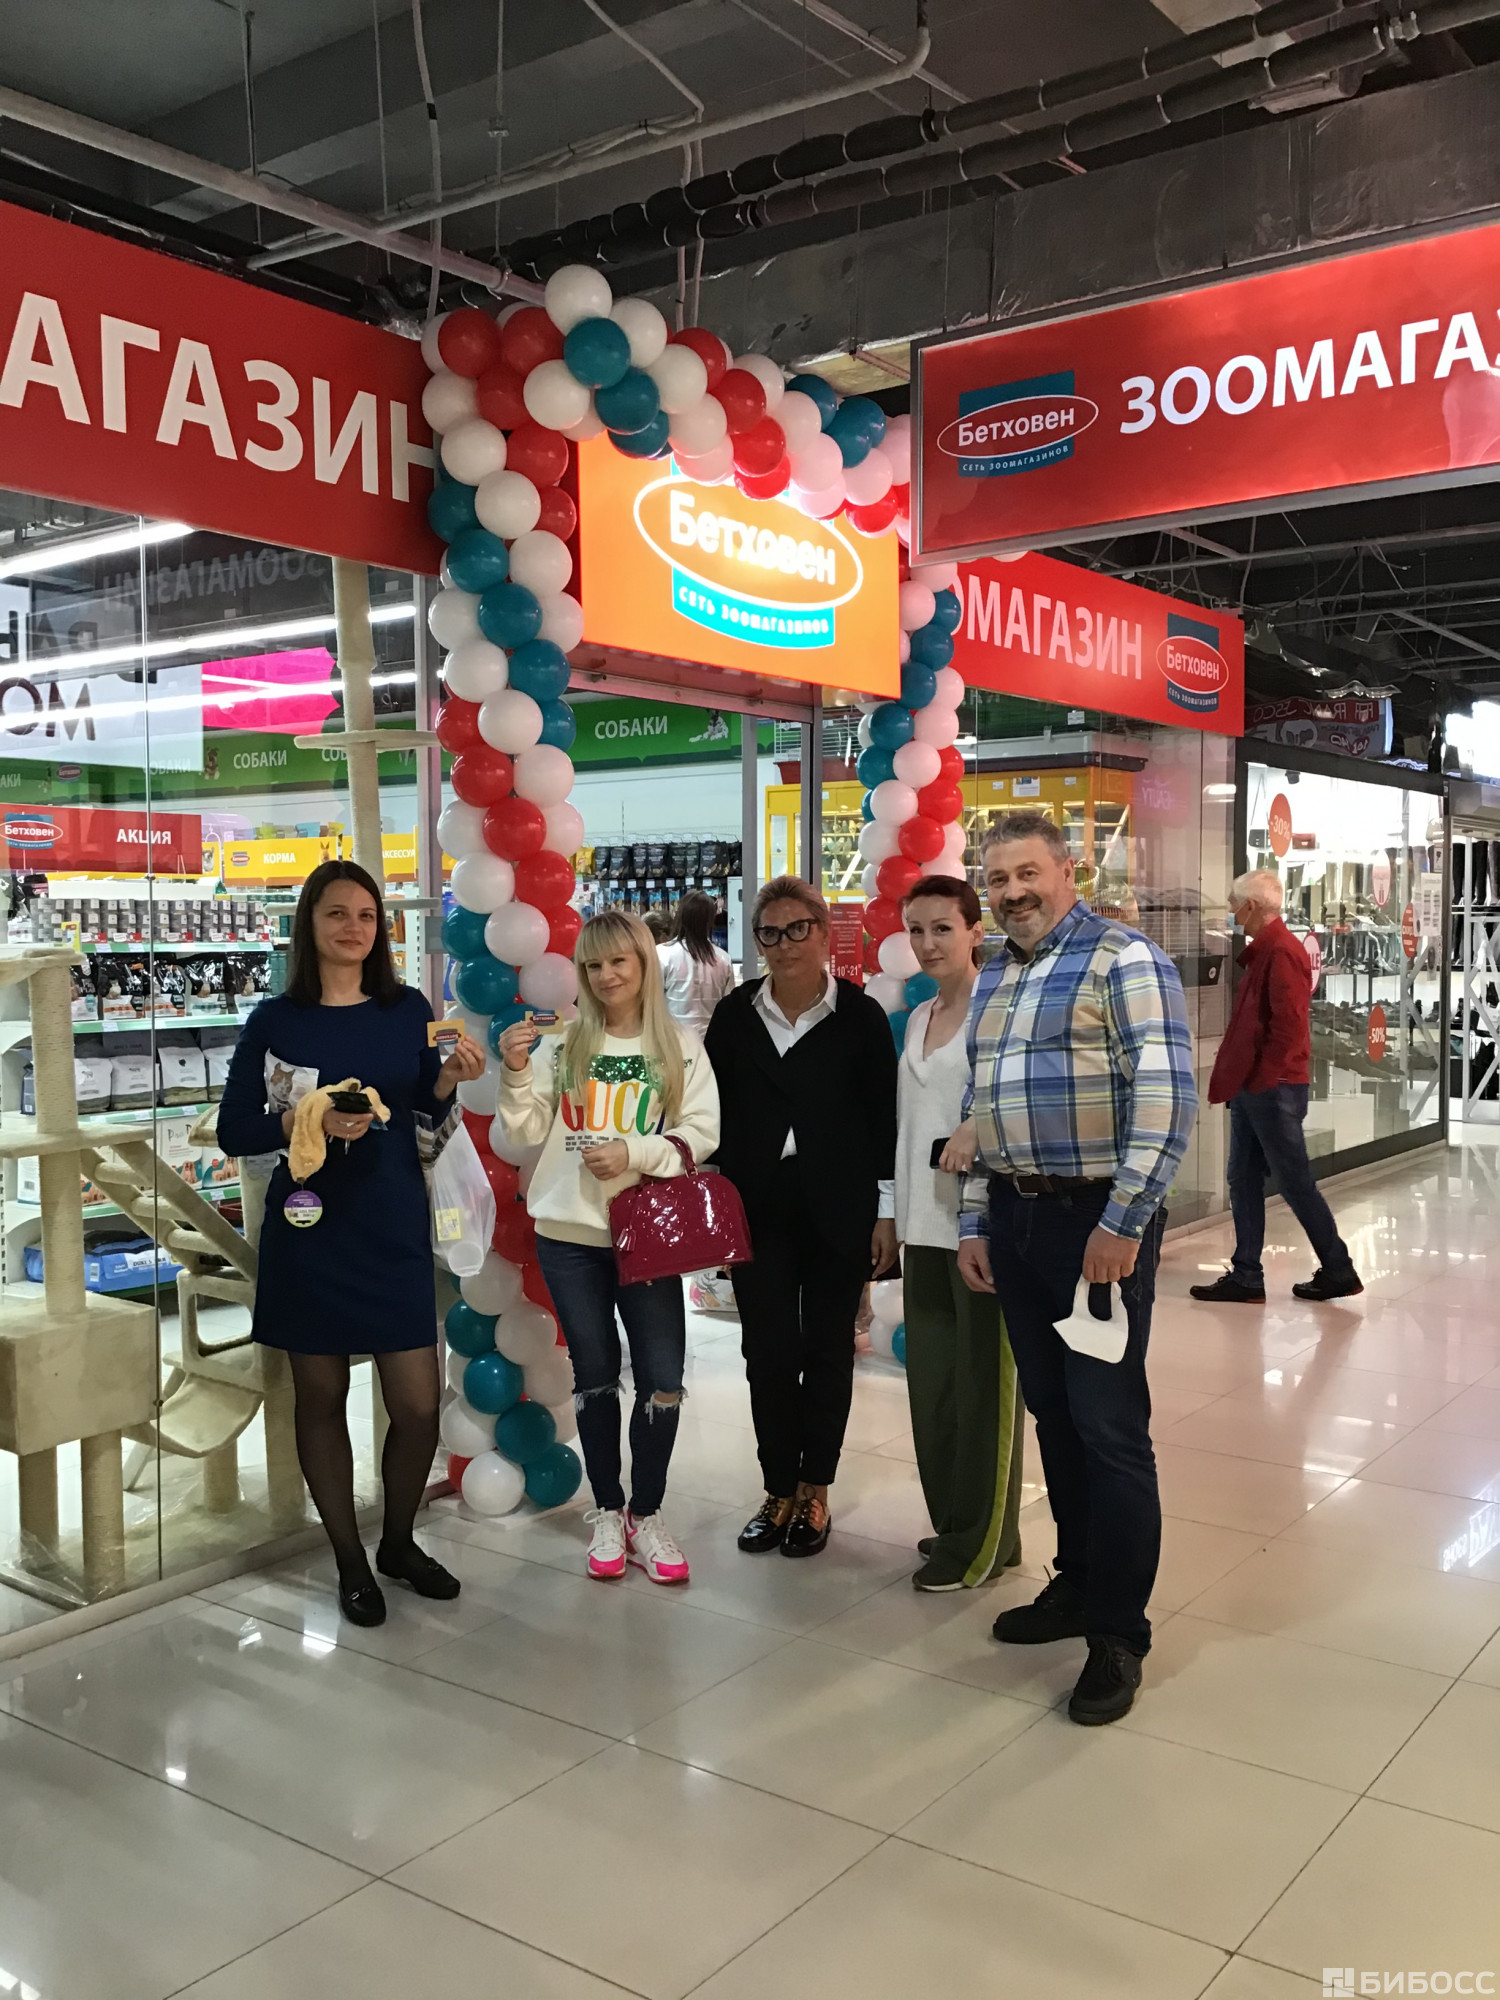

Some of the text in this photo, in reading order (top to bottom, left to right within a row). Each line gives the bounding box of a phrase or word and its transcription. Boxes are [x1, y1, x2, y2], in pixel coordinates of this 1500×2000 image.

[1120, 310, 1500, 434] ЗООМАГА
[958, 407, 1075, 447] Бетховен
[962, 445, 1069, 472] СЕТЬ ЗООМАГАЗИНОВ
[670, 489, 836, 585] Бетховен
[679, 586, 829, 635] СЕТЬ ЗООМАГАЗИНОВ
[1166, 644, 1220, 680] Бетховен
[595, 716, 668, 740] СОБАКИ
[233, 750, 287, 769] СОБАКИ
[5, 824, 54, 837] Бетховен
[117, 829, 172, 845] АКЦИЯ
[1270, 815, 1291, 840] -30%
[263, 852, 297, 864] КОРМА
[1369, 1028, 1386, 1044] -50%
